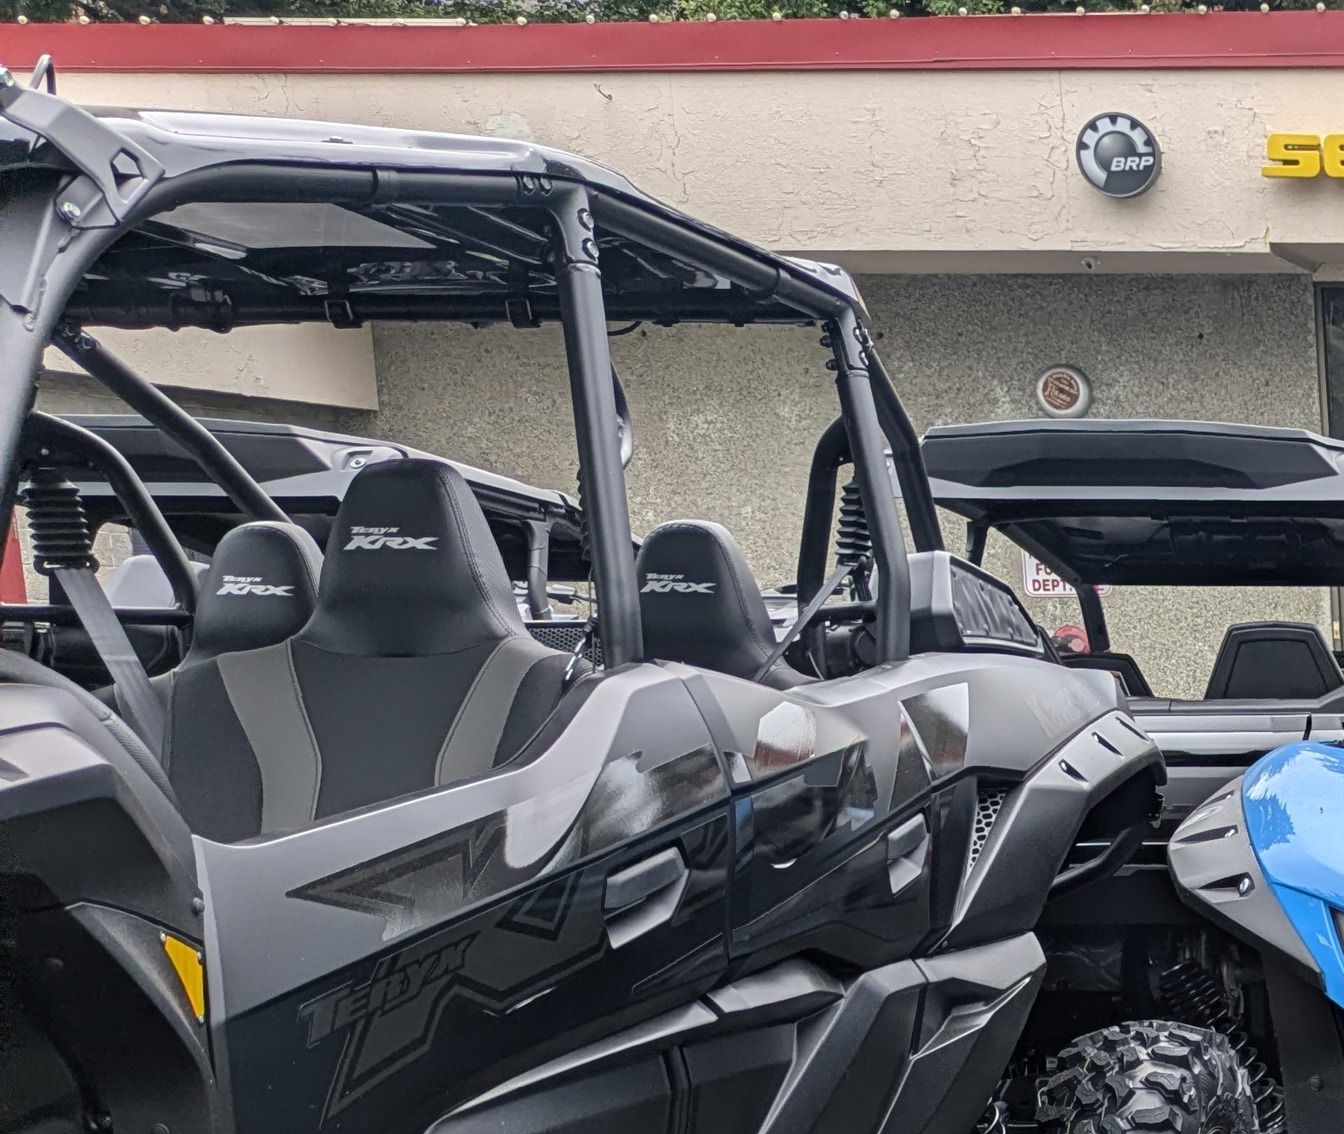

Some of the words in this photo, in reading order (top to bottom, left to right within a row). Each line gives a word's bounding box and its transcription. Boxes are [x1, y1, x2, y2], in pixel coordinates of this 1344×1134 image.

[1110, 154, 1155, 172] BRP
[343, 535, 440, 550] KRX
[216, 583, 295, 597] KRX
[640, 580, 717, 594] KRX
